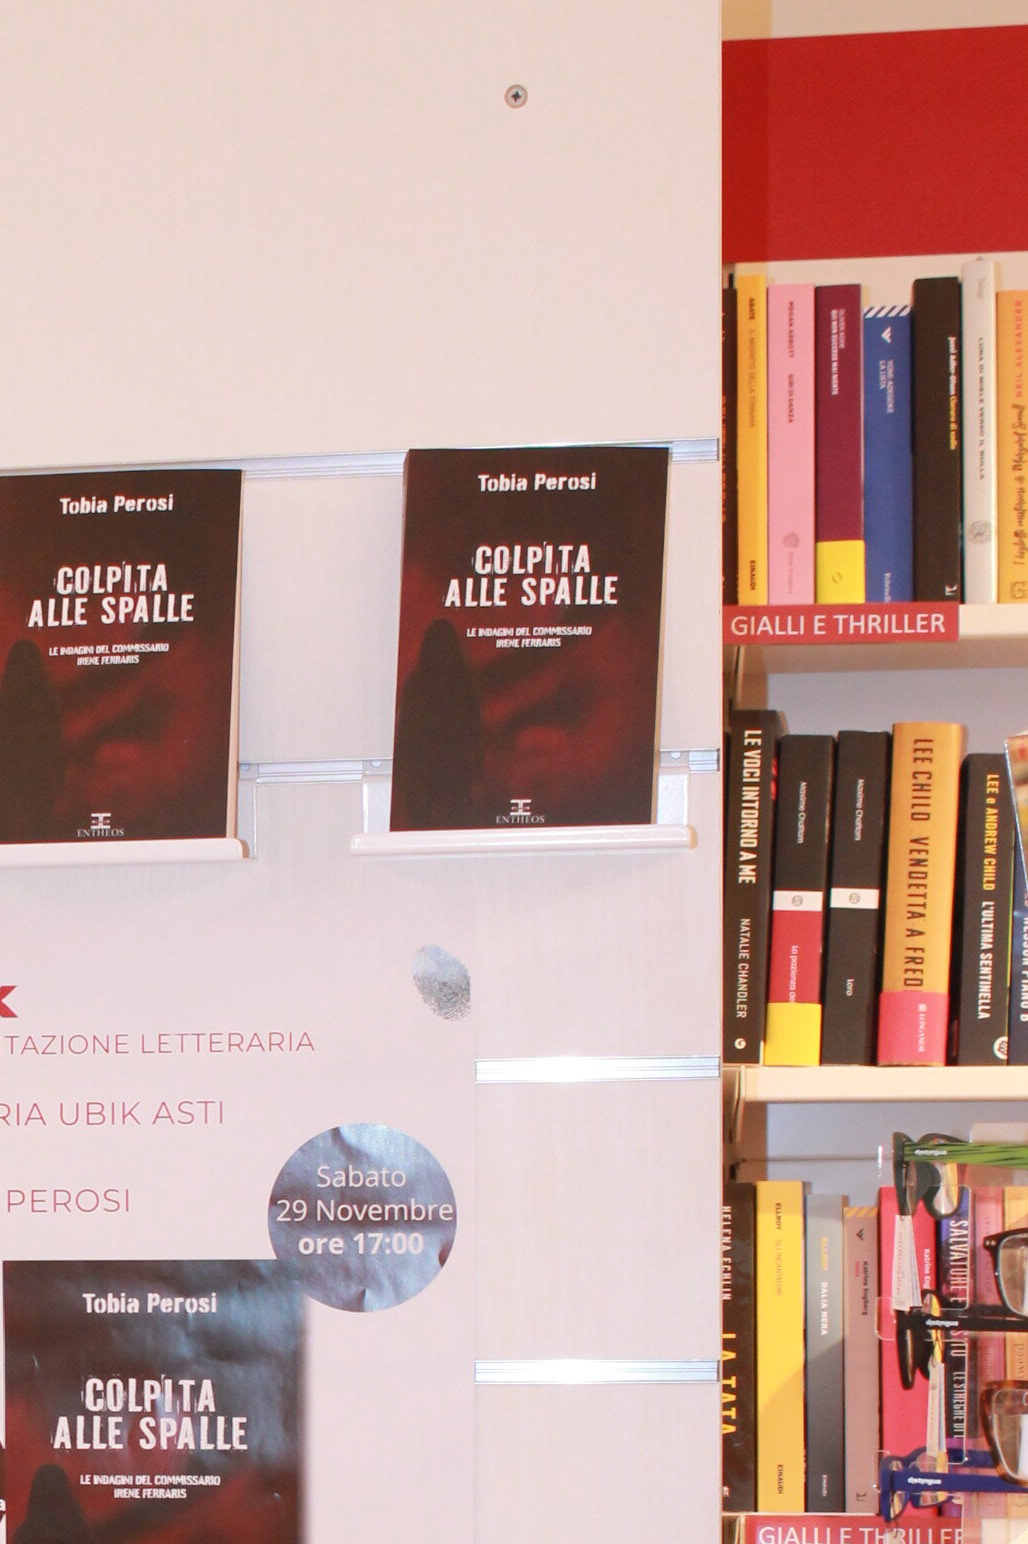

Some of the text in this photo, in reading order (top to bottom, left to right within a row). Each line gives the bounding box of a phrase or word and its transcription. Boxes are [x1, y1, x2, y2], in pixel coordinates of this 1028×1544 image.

[478, 473, 596, 491] Tobia Perosi
[60, 494, 173, 514] Tobia Perosi
[472, 545, 590, 574] COLPITA
[54, 564, 167, 594] COLPITA
[445, 576, 617, 607] ALLE SPALLE
[28, 594, 194, 627] ALLE SPALLE
[731, 614, 945, 635] GIALLI E THRILLER
[986, 774, 999, 794] LEE
[739, 730, 762, 883] LE VOCI INTORNO A ME
[984, 807, 998, 854] ANDREW
[904, 739, 933, 986] LEE CHILD VENDETTA A FRED
[983, 858, 996, 890] CHILD
[980, 901, 994, 949] L'ULTIMA
[736, 919, 750, 1018] NATALIE CHANDLER
[978, 953, 992, 1019] SENTINELLA
[142, 1032, 314, 1053] LETTERARIA
[60, 1102, 140, 1125] UBIK
[152, 1101, 222, 1124] ASTI
[317, 1165, 406, 1188] Sabato
[8, 1189, 128, 1212] PEROSI
[276, 1194, 453, 1222] 29 Novembre
[299, 1233, 423, 1255] ore 17:00
[83, 1293, 217, 1314] Tobia Perosi
[82, 1378, 215, 1418] COLPITA
[54, 1416, 247, 1450] ALLE SPALLE
[114, 1488, 187, 1498] IRENE FERRARIS
